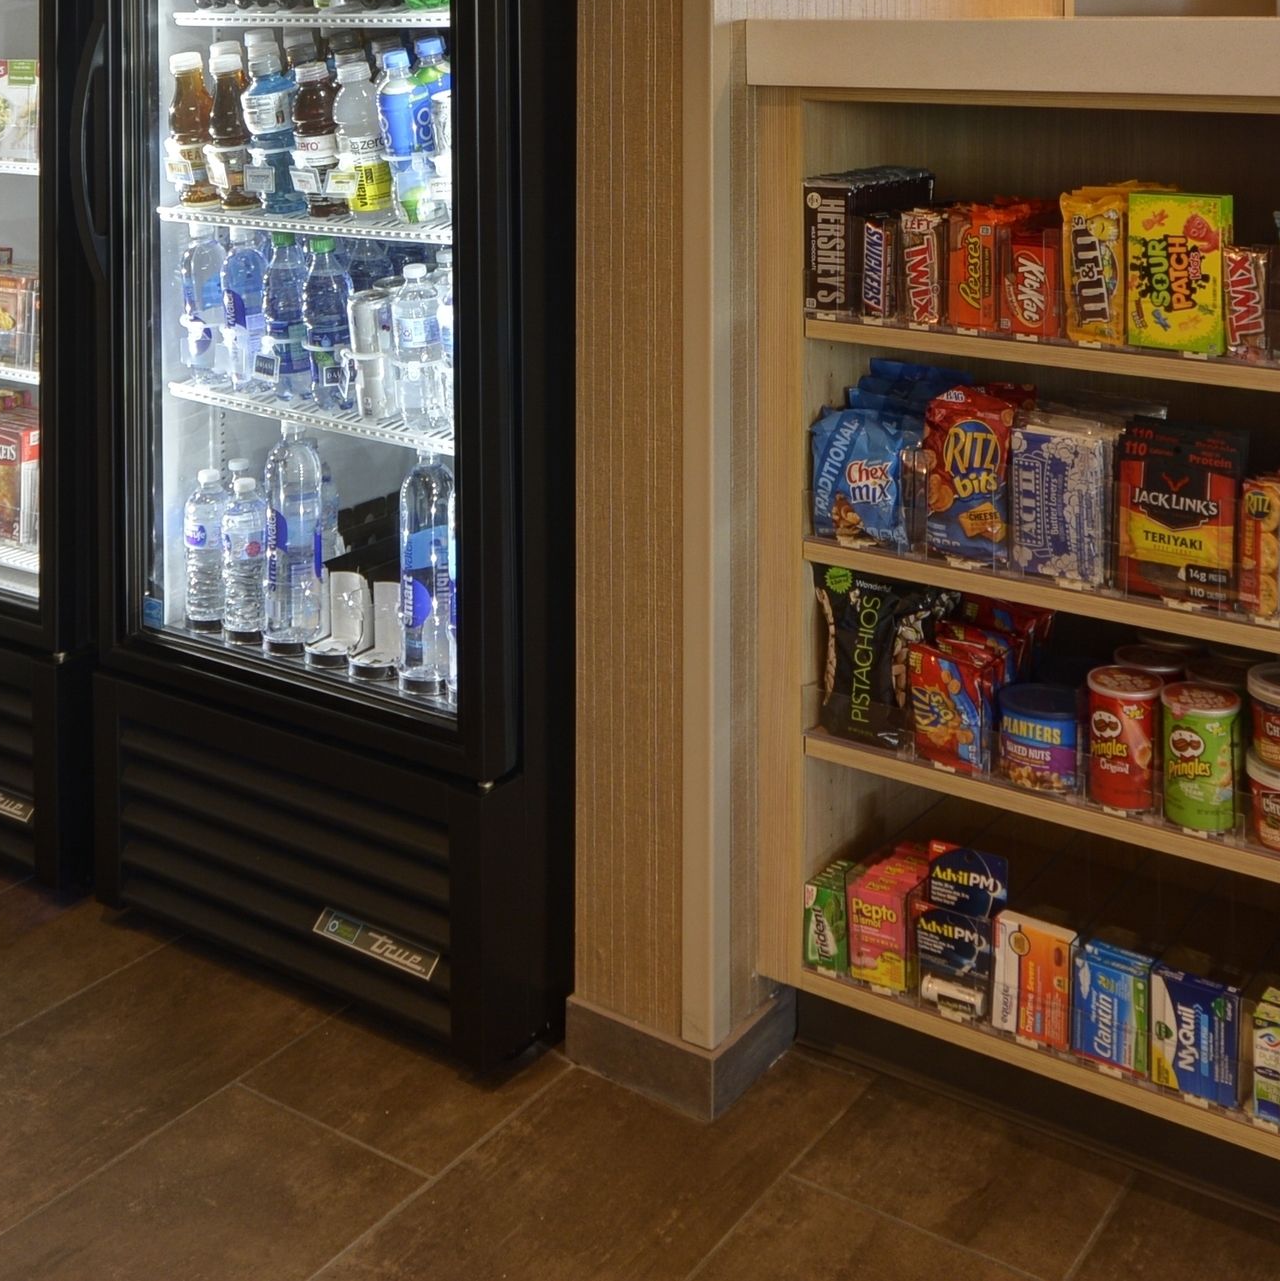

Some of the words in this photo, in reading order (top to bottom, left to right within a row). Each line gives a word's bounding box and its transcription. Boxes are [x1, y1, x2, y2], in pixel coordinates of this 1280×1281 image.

[817, 199, 845, 304] HERSHEY'S
[864, 224, 883, 308] SNICKERS
[905, 236, 935, 322] TWIX
[1148, 239, 1170, 308] SOUR
[1168, 235, 1194, 311] PATCH
[1228, 254, 1264, 344] TWIX
[947, 427, 998, 474] RITZ
[1125, 442, 1148, 456] 110
[1188, 453, 1233, 469] Protein
[816, 418, 860, 517] TRADITIONAL
[848, 463, 889, 485] Chex
[851, 481, 890, 503] mix
[953, 471, 998, 497] bits
[1049, 478, 1058, 507] Lovers
[1133, 487, 1170, 509] JACK
[1171, 494, 1218, 516] LINK'S
[1245, 492, 1270, 515] RITZ
[1021, 497, 1036, 537] ACT
[1050, 507, 1059, 535] Butter
[1143, 529, 1203, 551] TERIYAKI
[855, 579, 893, 593] Wonderful
[851, 596, 881, 722] PISTACHIOS
[1002, 715, 1061, 745] PLANTERS
[1028, 747, 1052, 762] NUTS
[1169, 760, 1211, 779] Pringles
[931, 865, 968, 886] Advil
[968, 874, 995, 892] PM
[852, 897, 897, 924] Pepto
[813, 906, 831, 960] Trident
[918, 917, 953, 937] Advil
[954, 927, 979, 945] PM
[368, 930, 425, 972] true
[1026, 960, 1035, 992] Severe
[1025, 993, 1035, 1033] DayTime
[1094, 994, 1113, 1058] Claritin
[1177, 1004, 1198, 1072] NyQuil
